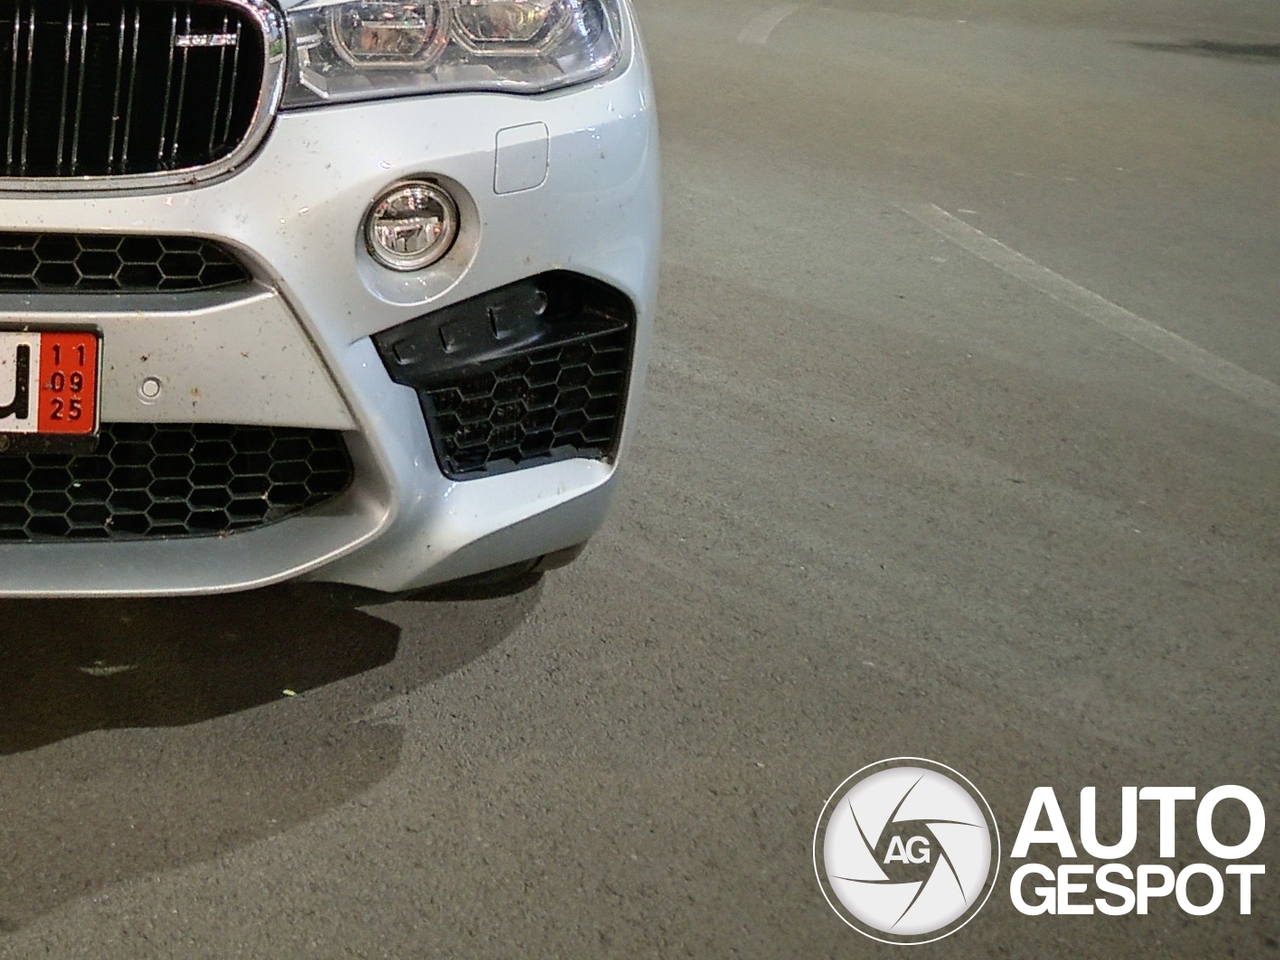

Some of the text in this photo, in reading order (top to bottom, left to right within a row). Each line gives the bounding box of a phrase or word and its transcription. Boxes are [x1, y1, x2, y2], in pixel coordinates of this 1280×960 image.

[52, 343, 85, 367] 11
[50, 371, 83, 393] 09
[50, 398, 82, 420] 25
